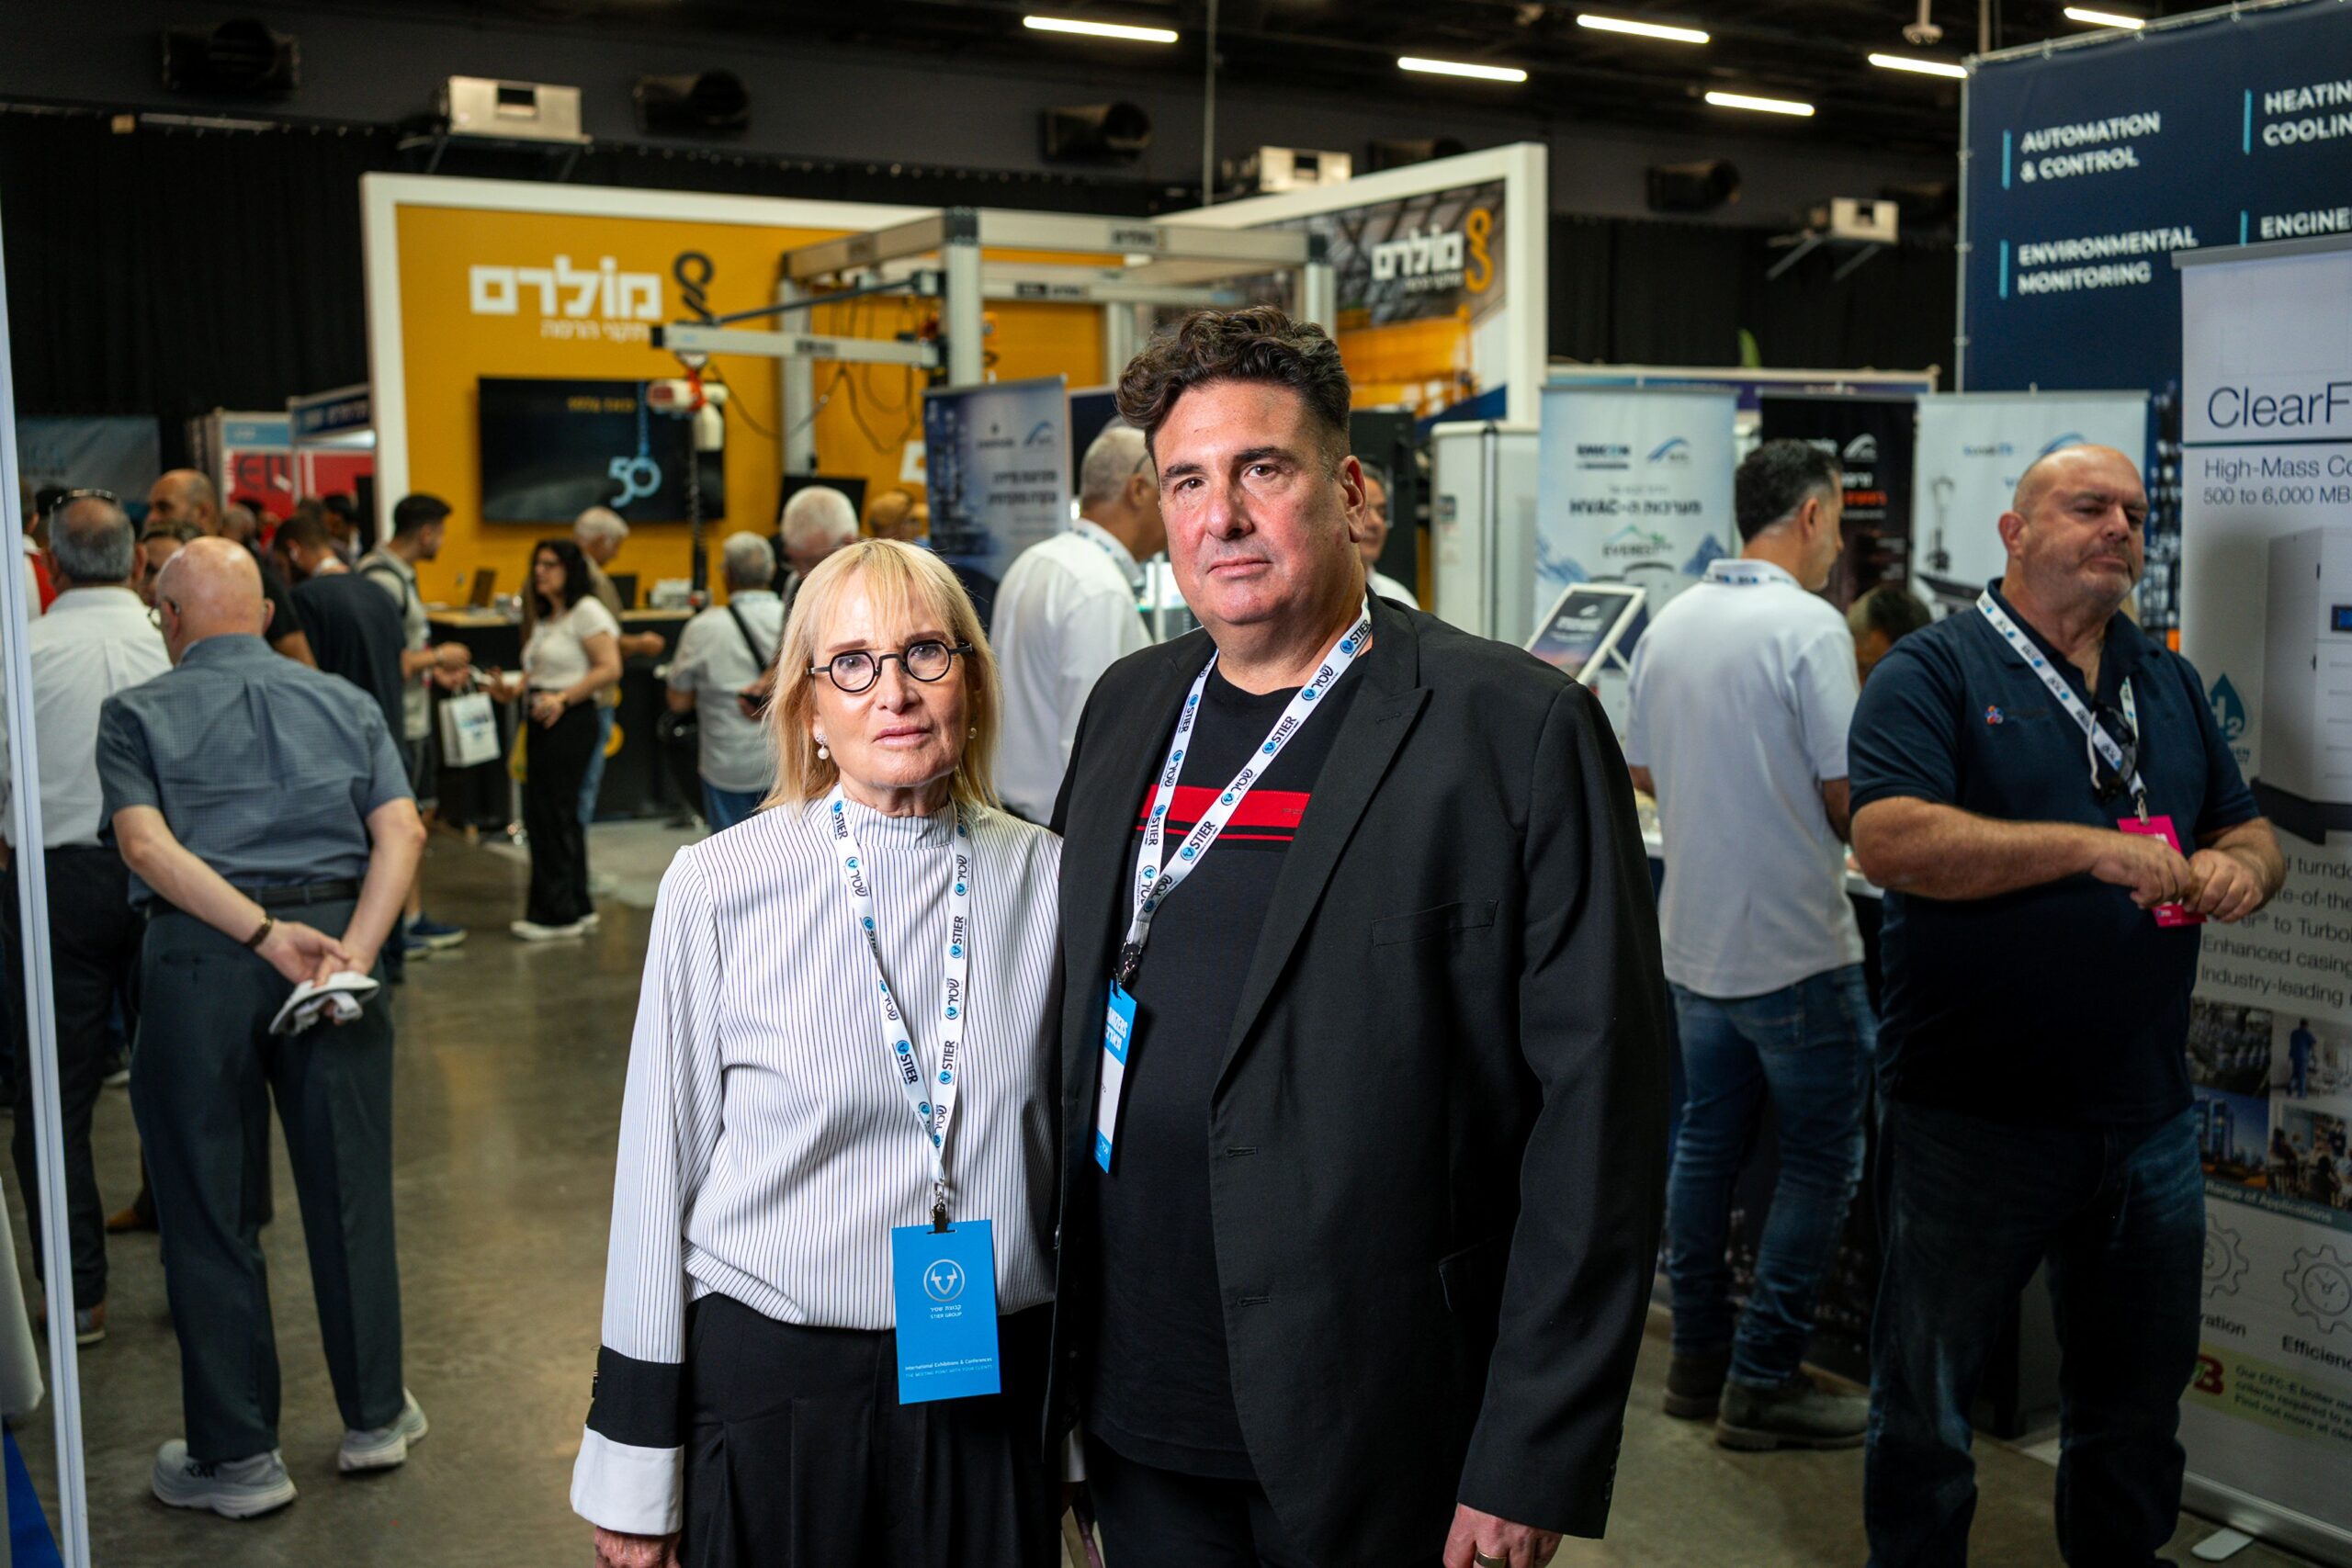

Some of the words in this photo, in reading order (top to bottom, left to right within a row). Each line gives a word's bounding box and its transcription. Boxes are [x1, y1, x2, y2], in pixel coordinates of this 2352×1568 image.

[2020, 111, 2162, 153] AUTOMATION
[2020, 161, 2036, 183] &
[2039, 145, 2139, 179] CONTROL
[2260, 208, 2352, 240] ENGINE
[2018, 226, 2199, 266] ENVIRONMENTAL
[2018, 260, 2153, 296] MONITORING
[2207, 381, 2352, 429] ClearF
[607, 456, 662, 508] 50
[2204, 456, 2320, 484] High-Mass
[2203, 486, 2234, 505] 500
[2240, 487, 2256, 505] to
[2262, 486, 2314, 506] 6,000
[1349, 618, 1372, 645] STIER
[1311, 663, 1334, 692] שטיר
[1181, 706, 1195, 733] STIER
[1271, 715, 1297, 745] STIER
[1231, 768, 1253, 795] שטיר
[834, 811, 848, 840] STIER
[1148, 816, 1161, 846] STIER
[1193, 820, 1216, 850] STIER
[850, 869, 869, 897] שטיר
[956, 854, 967, 882] שטיר
[953, 916, 964, 944] STIER
[2274, 916, 2291, 934] to
[2300, 917, 2352, 944] Turbo
[2202, 934, 2290, 964] Enhanced
[2297, 952, 2352, 980] casing
[946, 977, 959, 1006] שטיר
[2201, 964, 2344, 1008] Industry-leading
[899, 1054, 918, 1084] STIER
[942, 1040, 956, 1070] STIER
